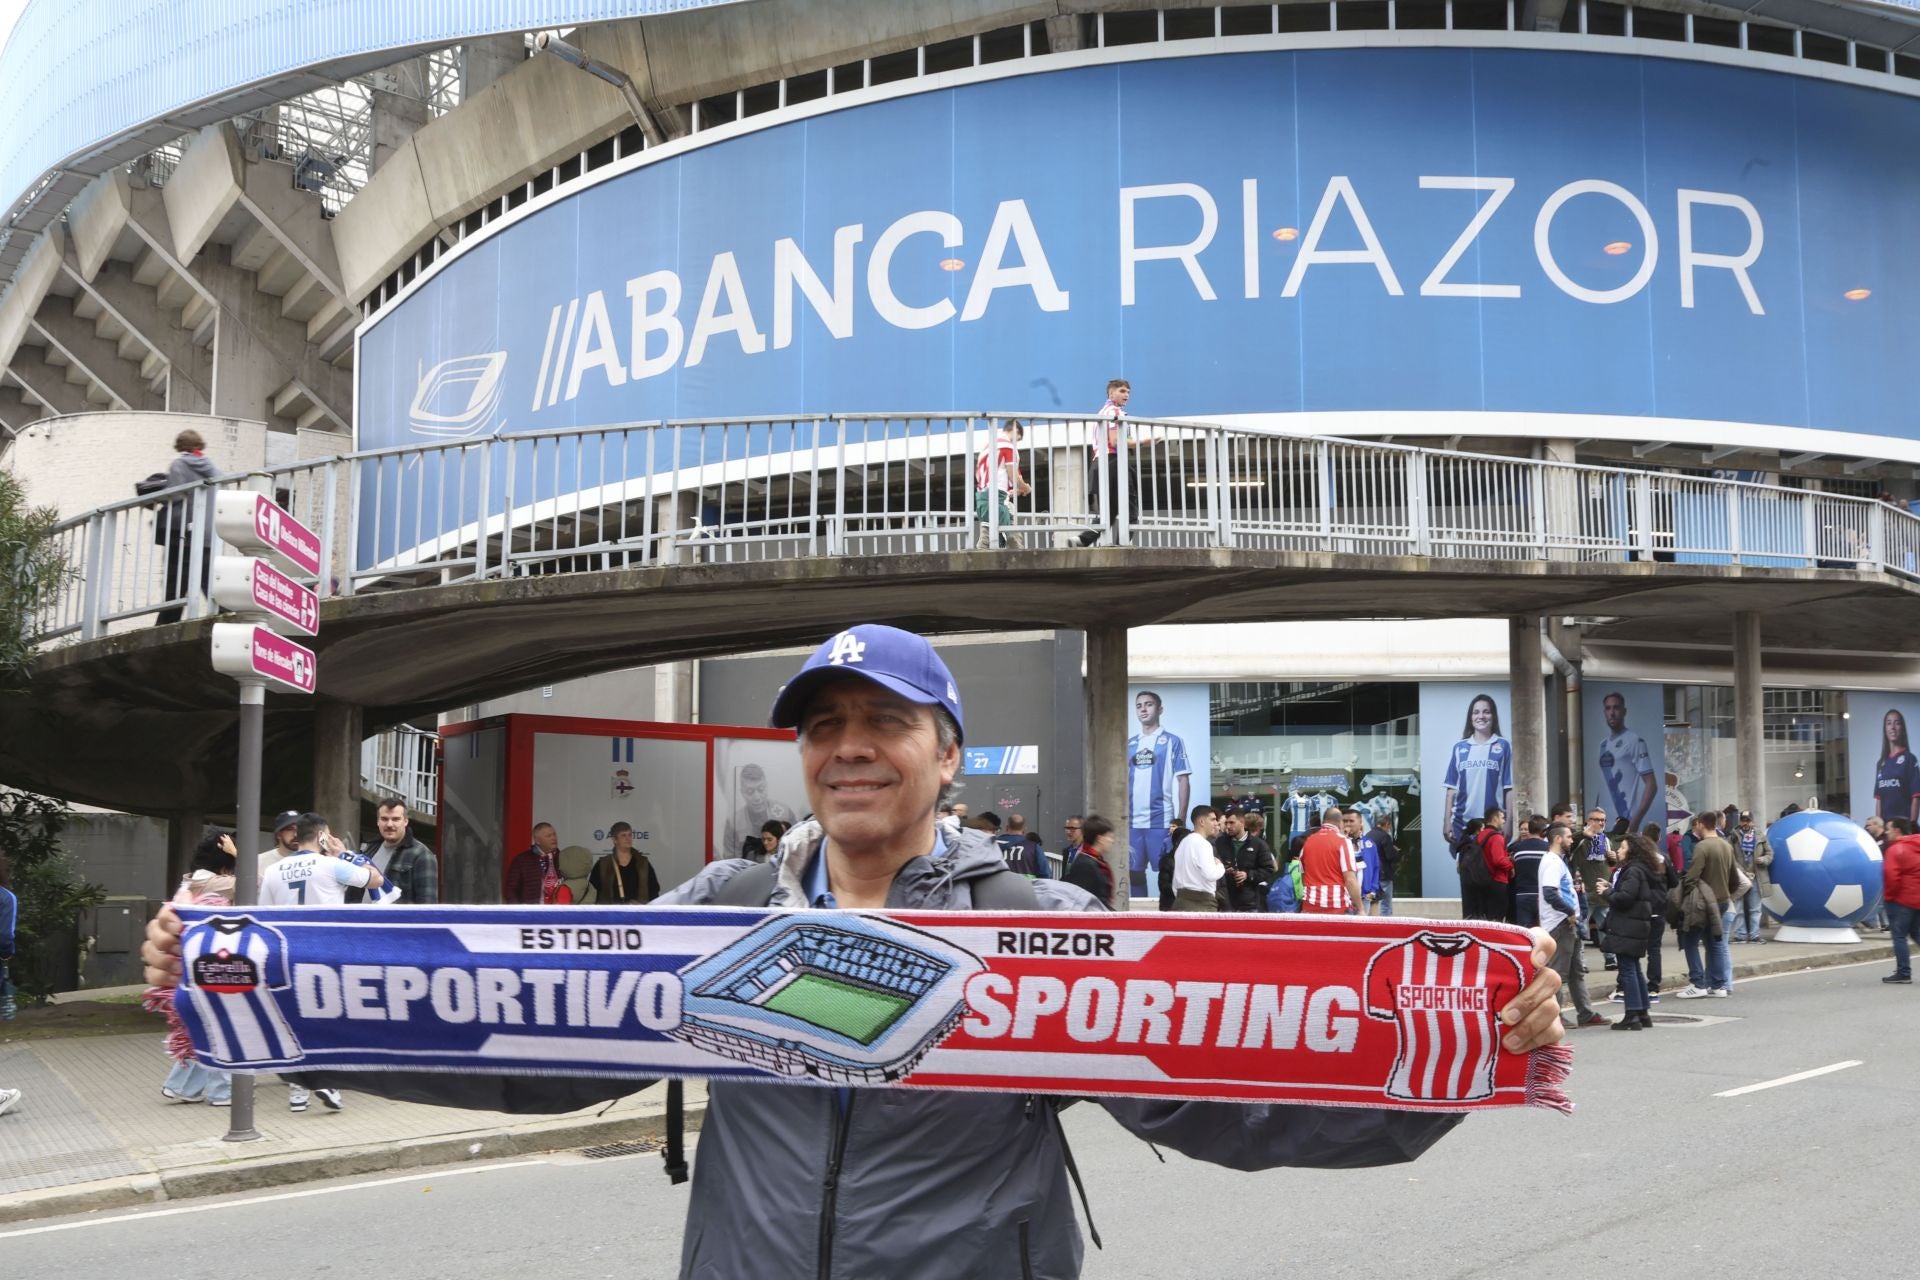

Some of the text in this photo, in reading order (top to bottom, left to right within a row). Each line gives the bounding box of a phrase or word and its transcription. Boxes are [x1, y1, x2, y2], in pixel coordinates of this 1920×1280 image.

[564, 175, 1766, 402] ABANCA RIAZOR
[828, 630, 866, 666] LA
[973, 757, 990, 769] 27
[281, 868, 313, 881] LUCAS
[288, 880, 307, 905] 7
[520, 928, 1115, 956] ESTADIO RIAZOR
[294, 963, 1361, 1054] DEPORTIVO SPORTING
[1398, 986, 1487, 1011] SPORTING
